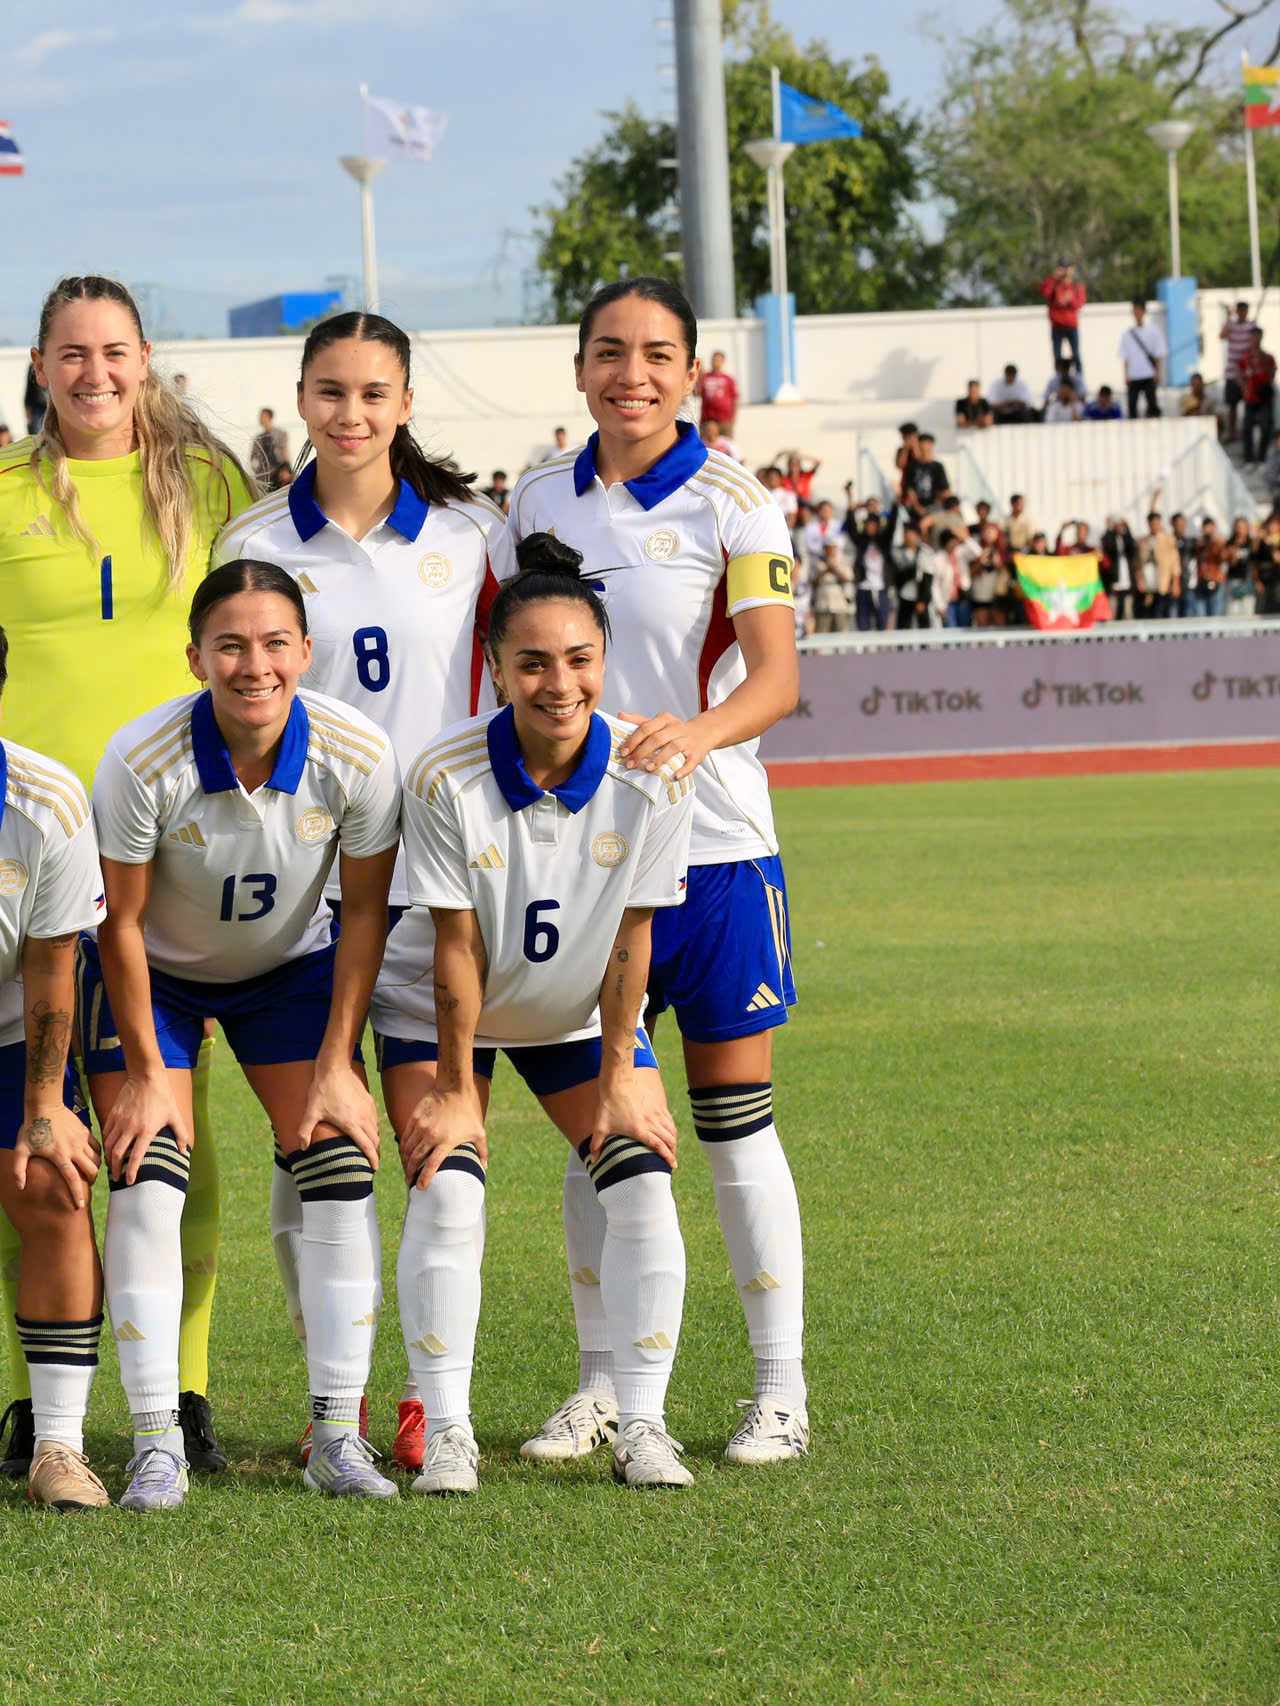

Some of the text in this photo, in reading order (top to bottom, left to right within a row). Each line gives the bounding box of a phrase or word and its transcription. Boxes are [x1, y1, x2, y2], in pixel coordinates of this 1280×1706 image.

[100, 555, 113, 620] 1
[768, 558, 790, 594] C
[352, 626, 391, 693] 8
[890, 687, 984, 714] TikTok
[1051, 680, 1145, 708] TikTok
[219, 872, 277, 923] 13
[522, 899, 561, 964] 6
